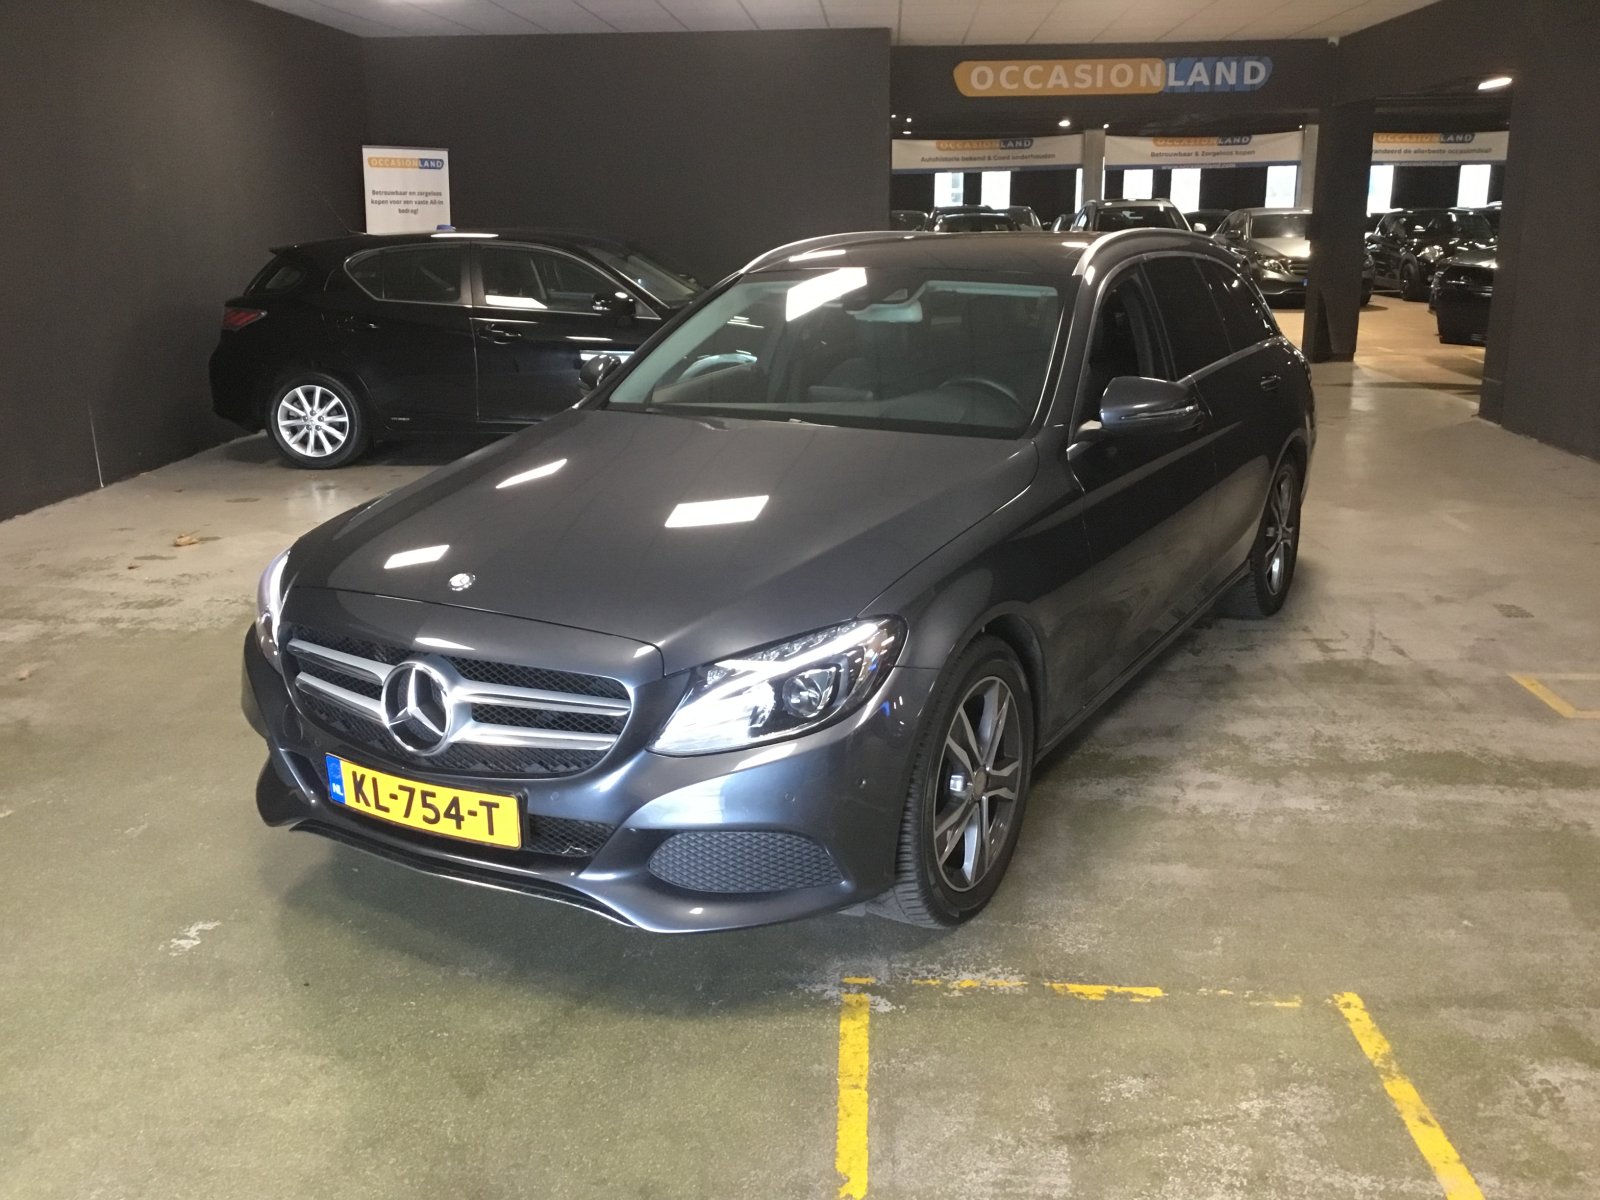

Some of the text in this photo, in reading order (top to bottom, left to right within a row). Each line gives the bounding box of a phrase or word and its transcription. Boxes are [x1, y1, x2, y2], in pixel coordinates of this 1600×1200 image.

[970, 60, 1266, 91] OCCASIONLAND
[939, 138, 1031, 149] OCCASIONLAND
[1377, 133, 1472, 143] OCCASIONLAND
[371, 158, 442, 168] OCCASIONLAND
[331, 782, 344, 796] NL
[351, 770, 500, 836] KL-754-T
